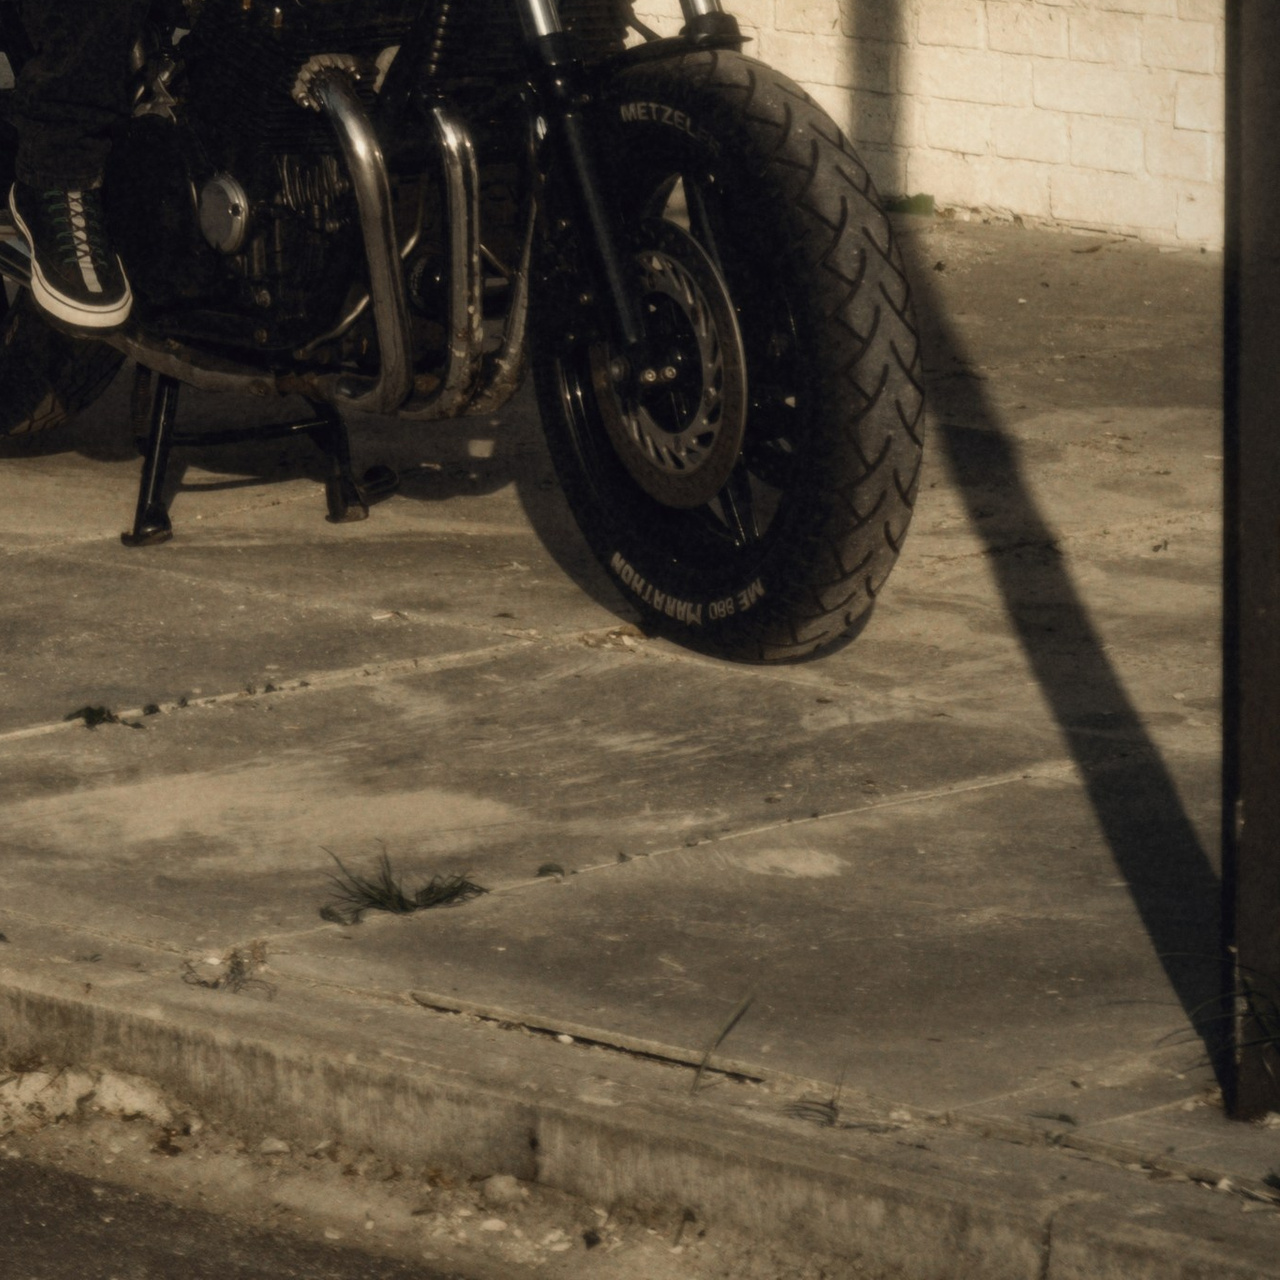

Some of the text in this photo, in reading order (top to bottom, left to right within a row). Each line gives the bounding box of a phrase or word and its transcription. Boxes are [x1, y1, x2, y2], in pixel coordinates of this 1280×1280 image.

[610, 551, 766, 627] ME 880 MARATHON
